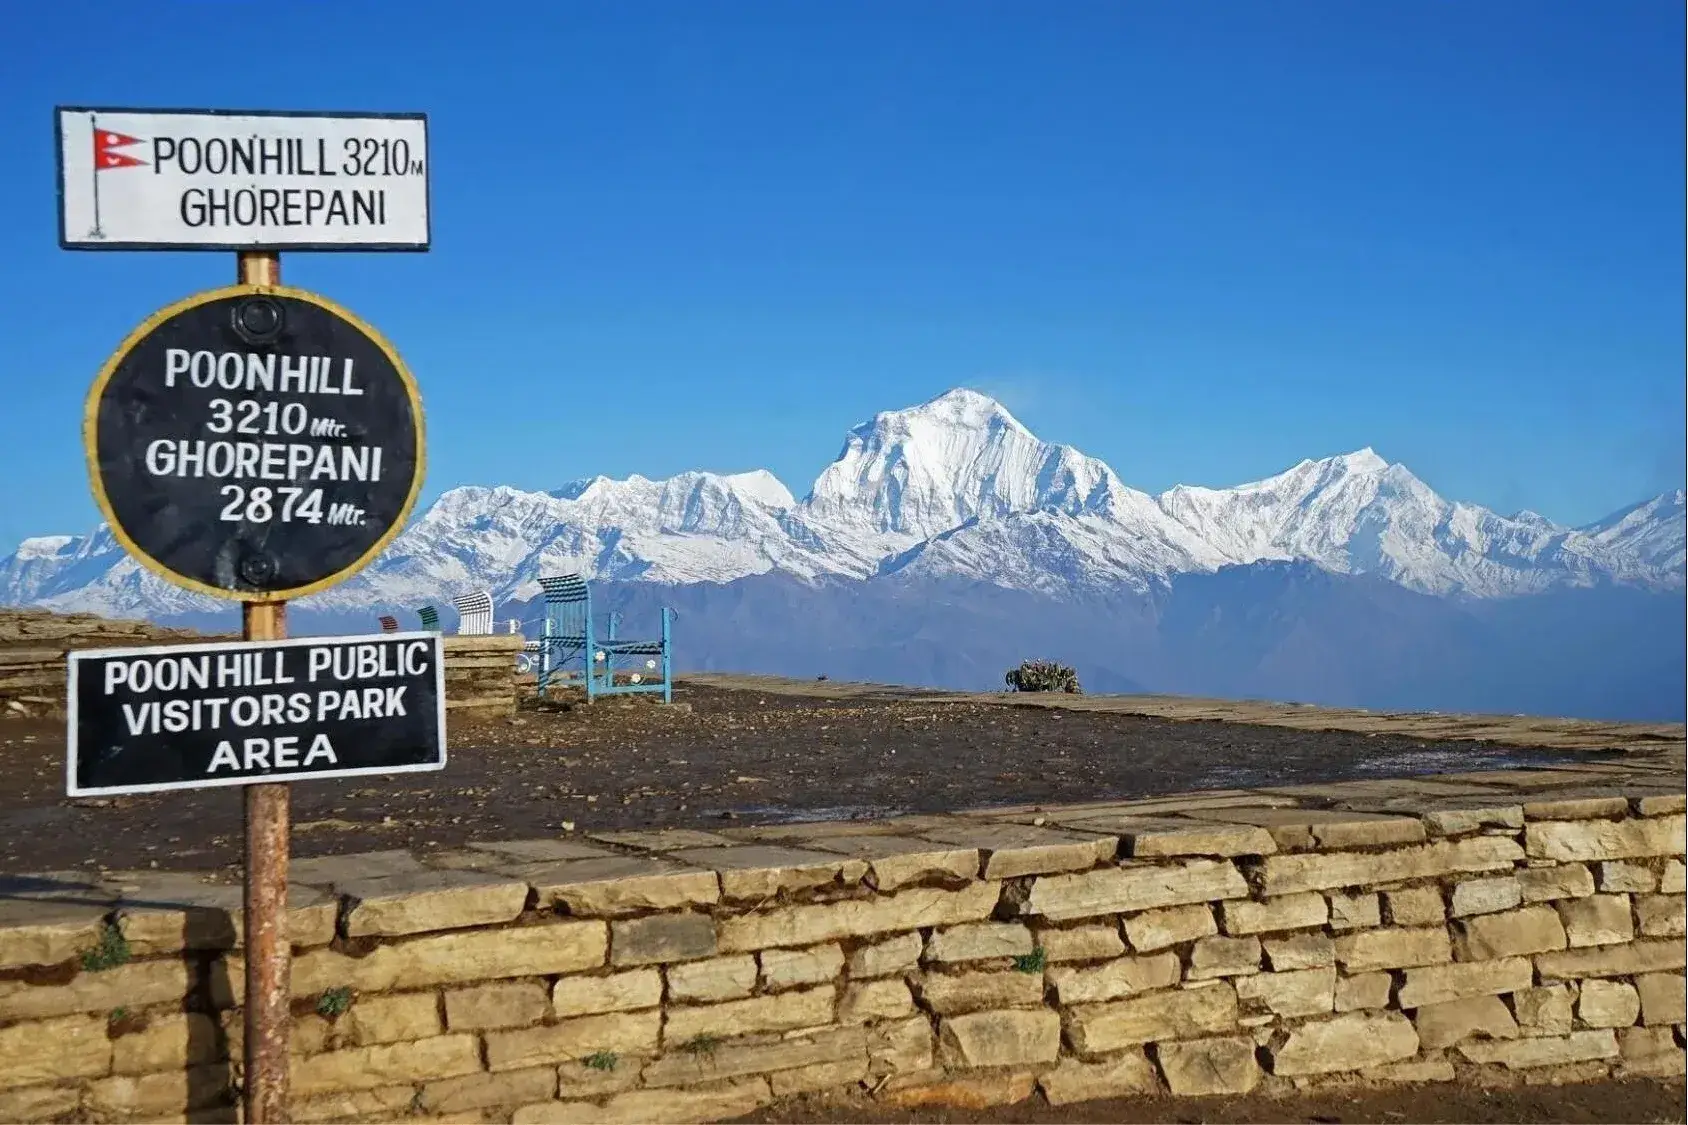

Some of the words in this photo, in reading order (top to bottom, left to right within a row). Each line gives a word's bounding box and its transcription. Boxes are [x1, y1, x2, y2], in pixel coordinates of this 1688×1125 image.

[180, 188, 386, 227] GHOREPANI
[145, 440, 383, 482] GHOREPANI
[220, 485, 325, 524] 2874
[308, 641, 430, 682] PUBLIC
[122, 692, 311, 736] VISITORS
[316, 685, 408, 721] PARK
[205, 733, 338, 773] AREA
